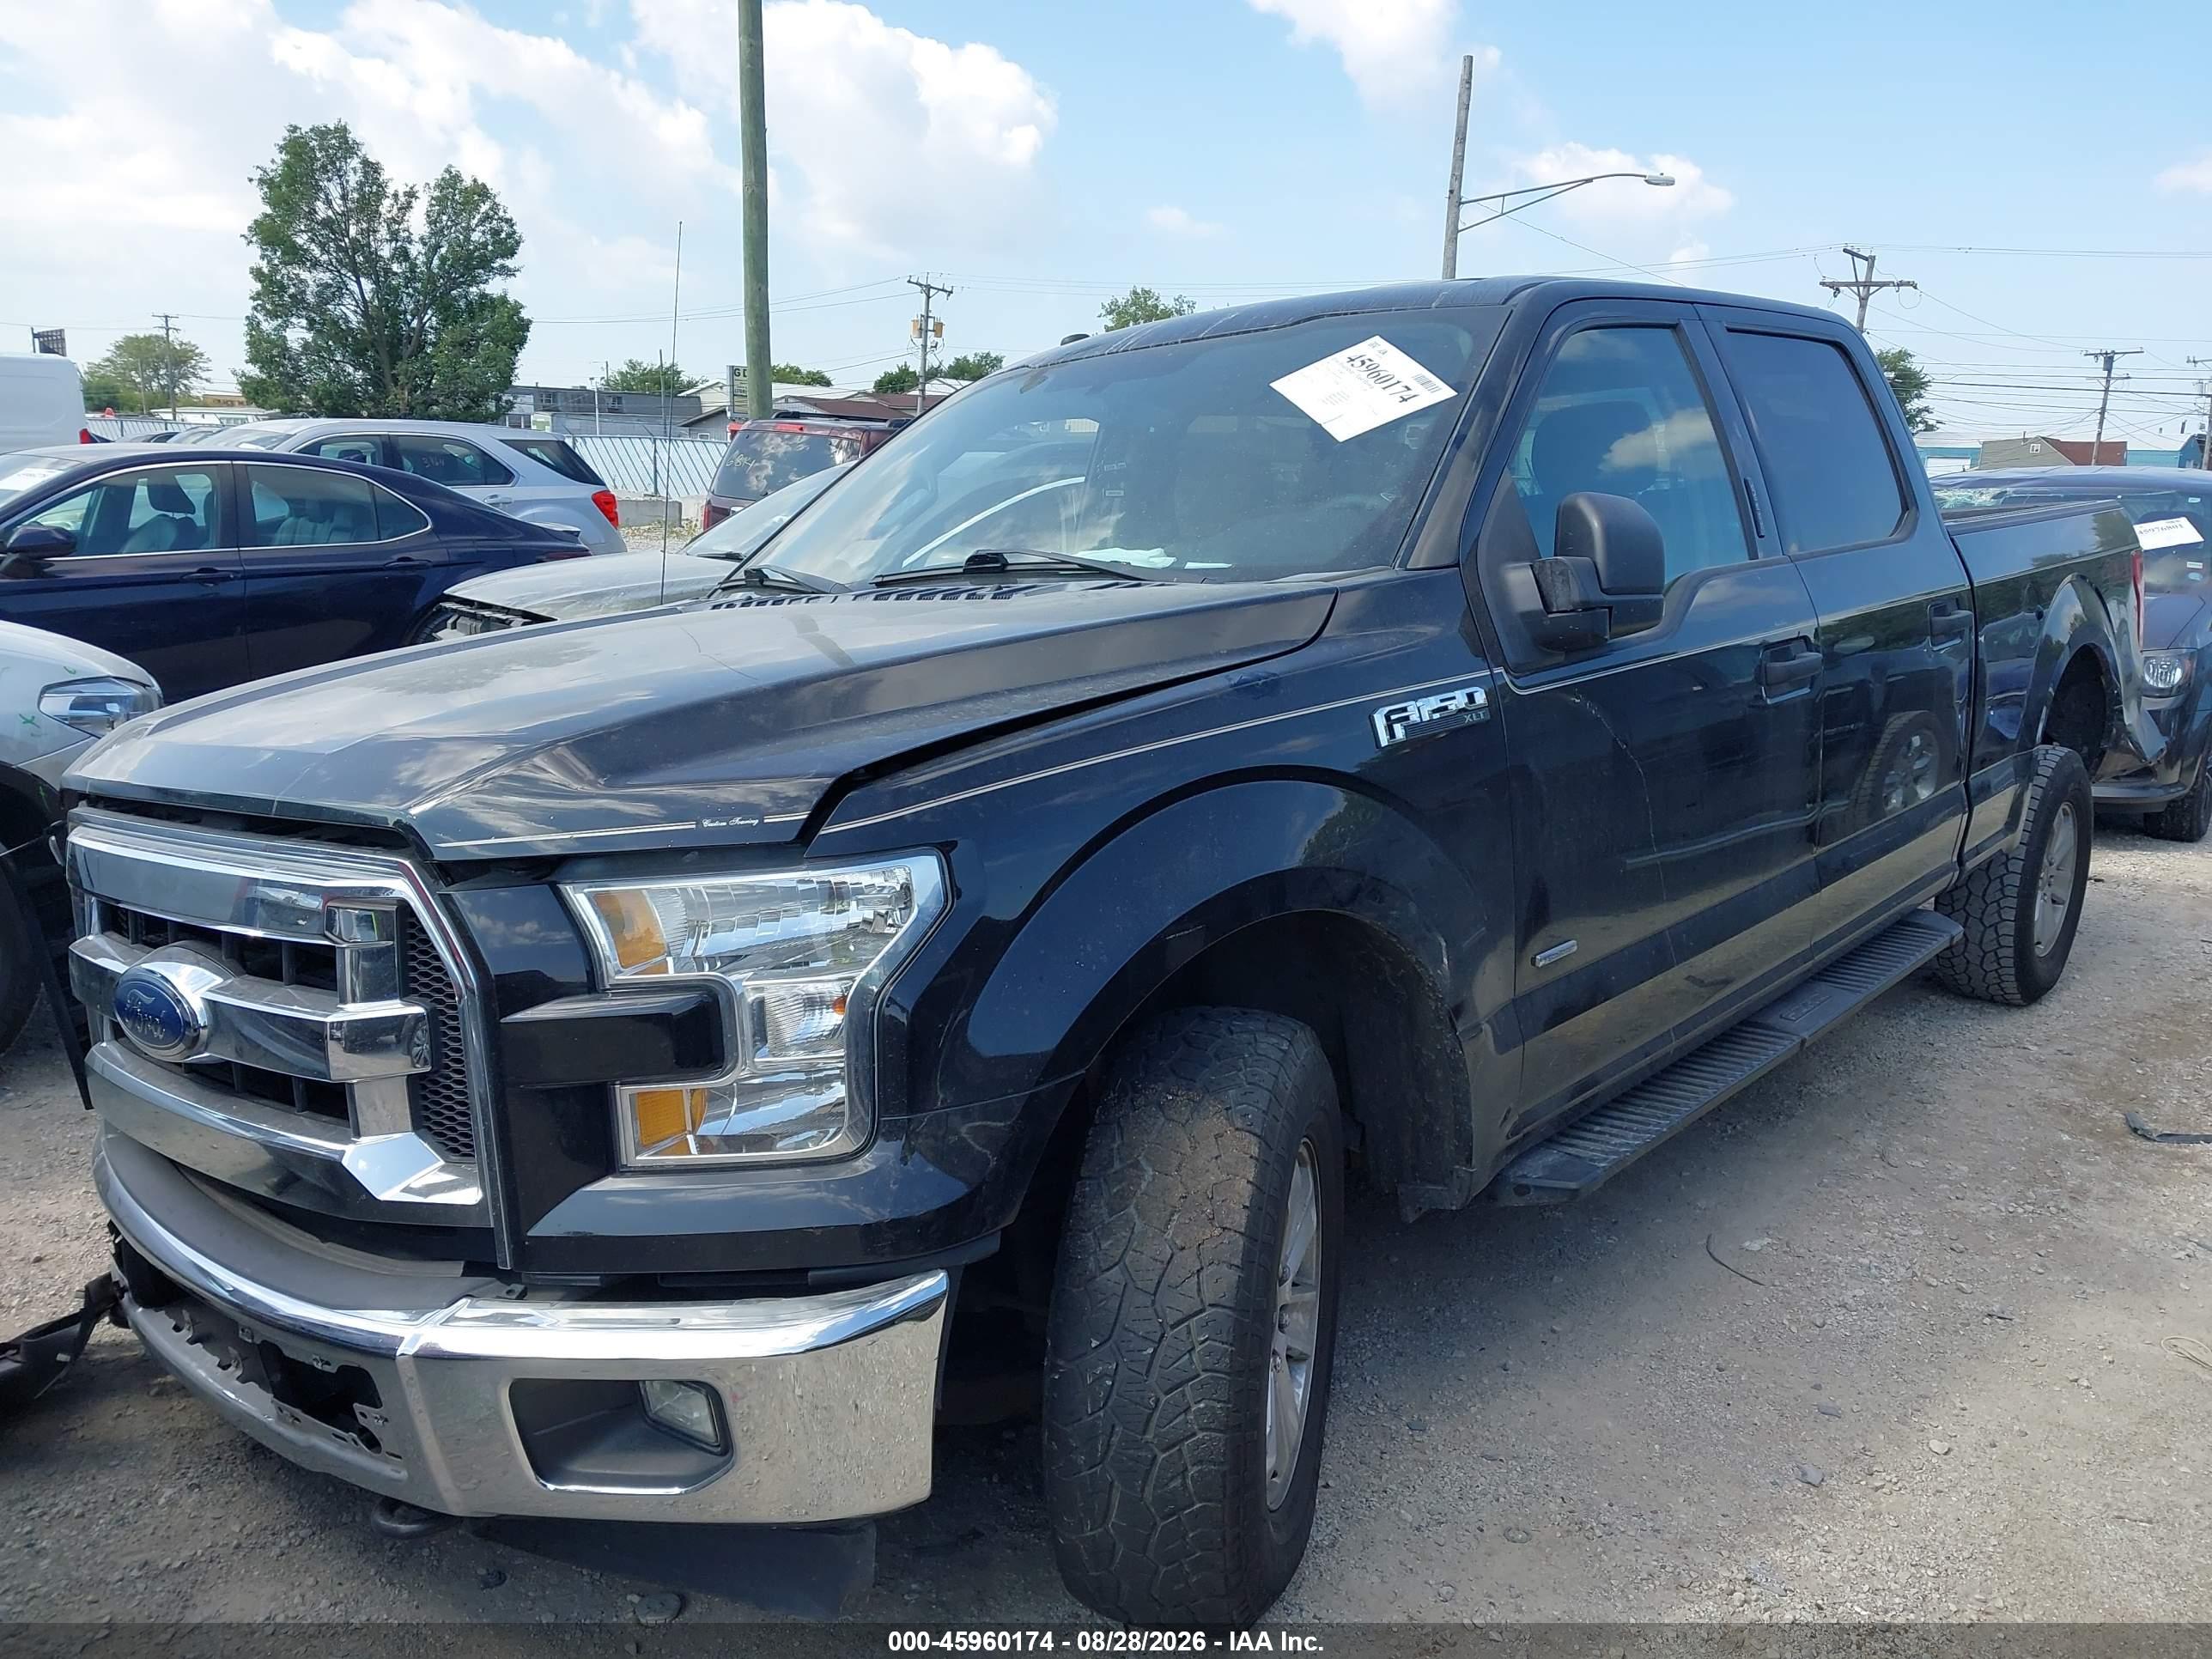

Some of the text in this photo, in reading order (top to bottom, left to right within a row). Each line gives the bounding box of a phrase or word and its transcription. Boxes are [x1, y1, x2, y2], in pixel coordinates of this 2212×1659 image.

[1346, 354, 1419, 404] 45960174
[1463, 709, 1487, 724] XLT
[125, 988, 167, 1040] Ford
